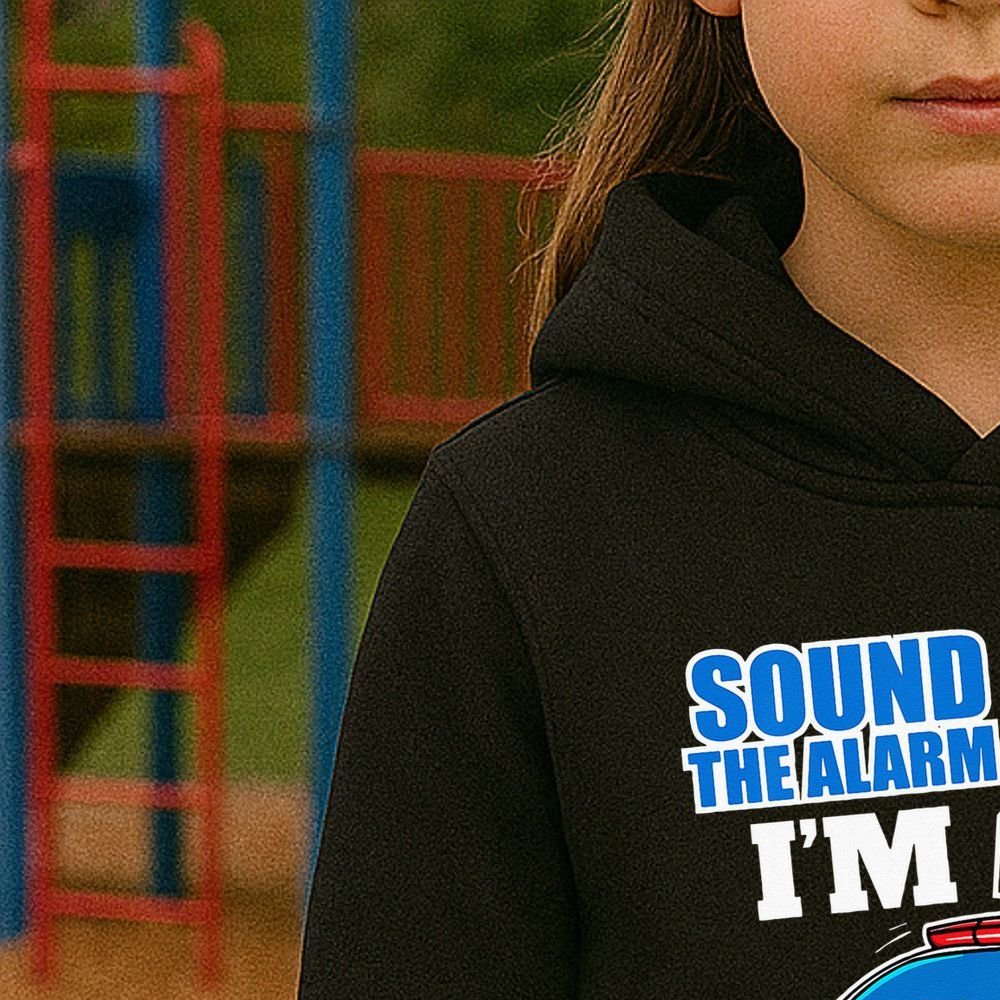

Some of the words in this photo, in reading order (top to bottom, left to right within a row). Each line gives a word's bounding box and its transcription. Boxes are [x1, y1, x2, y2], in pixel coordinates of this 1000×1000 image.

[691, 634, 988, 743] SOUND
[688, 744, 795, 808] THE
[807, 726, 998, 797] ALARM
[750, 806, 959, 921] I'M
